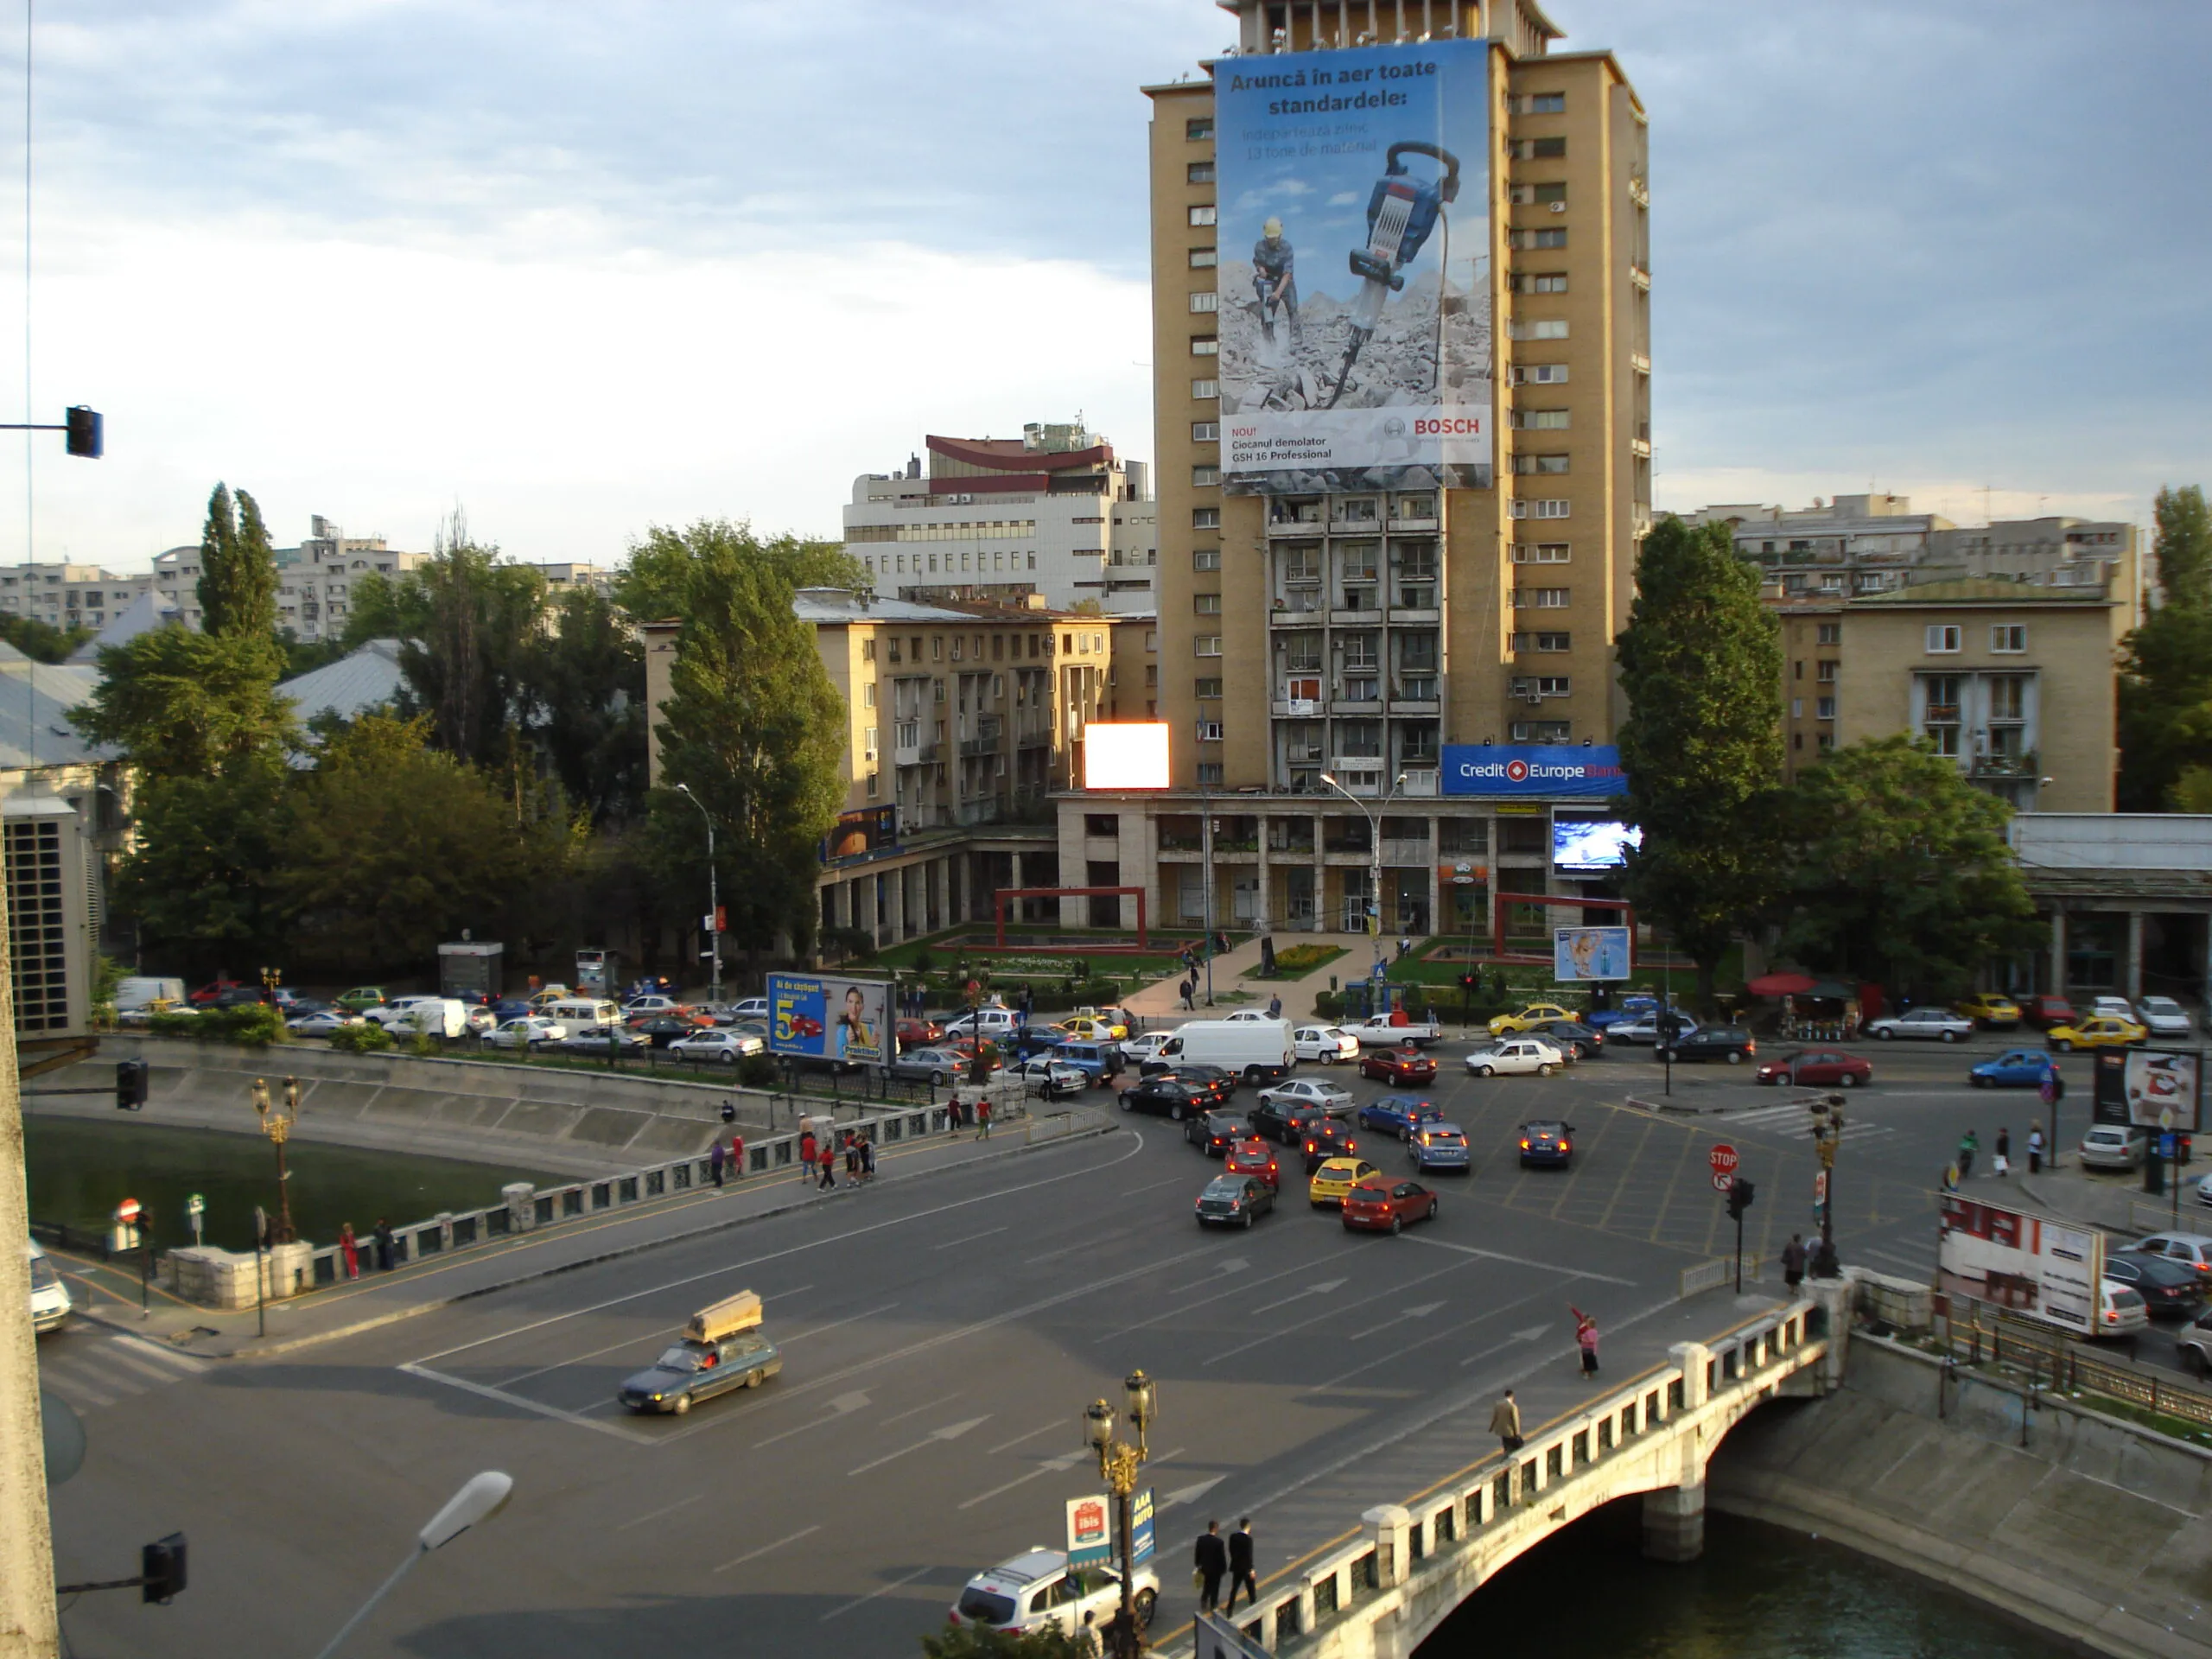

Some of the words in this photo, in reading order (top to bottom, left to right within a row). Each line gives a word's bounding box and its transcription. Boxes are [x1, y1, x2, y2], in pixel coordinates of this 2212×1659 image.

[1230, 69, 1306, 92] Aruncă
[1313, 68, 1332, 86] în
[1338, 68, 1374, 84] aer
[1379, 60, 1438, 79] toate
[1268, 90, 1408, 115] standardele:
[1231, 428, 1256, 437] NOU!
[1414, 419, 1479, 435] BOSCH
[1232, 439, 1272, 450] Ciocanul
[1275, 437, 1326, 448] demolator
[1232, 453, 1253, 462] GSH
[1256, 452, 1268, 461] 16
[1270, 449, 1332, 461] Professional
[1460, 763, 1504, 778] Credit
[1529, 764, 1585, 781] Europe
[775, 1000, 796, 1040] 5
[1710, 1152, 1737, 1166] STOP
[1079, 1516, 1099, 1529] ibis
[1132, 1504, 1154, 1529] AUTO
